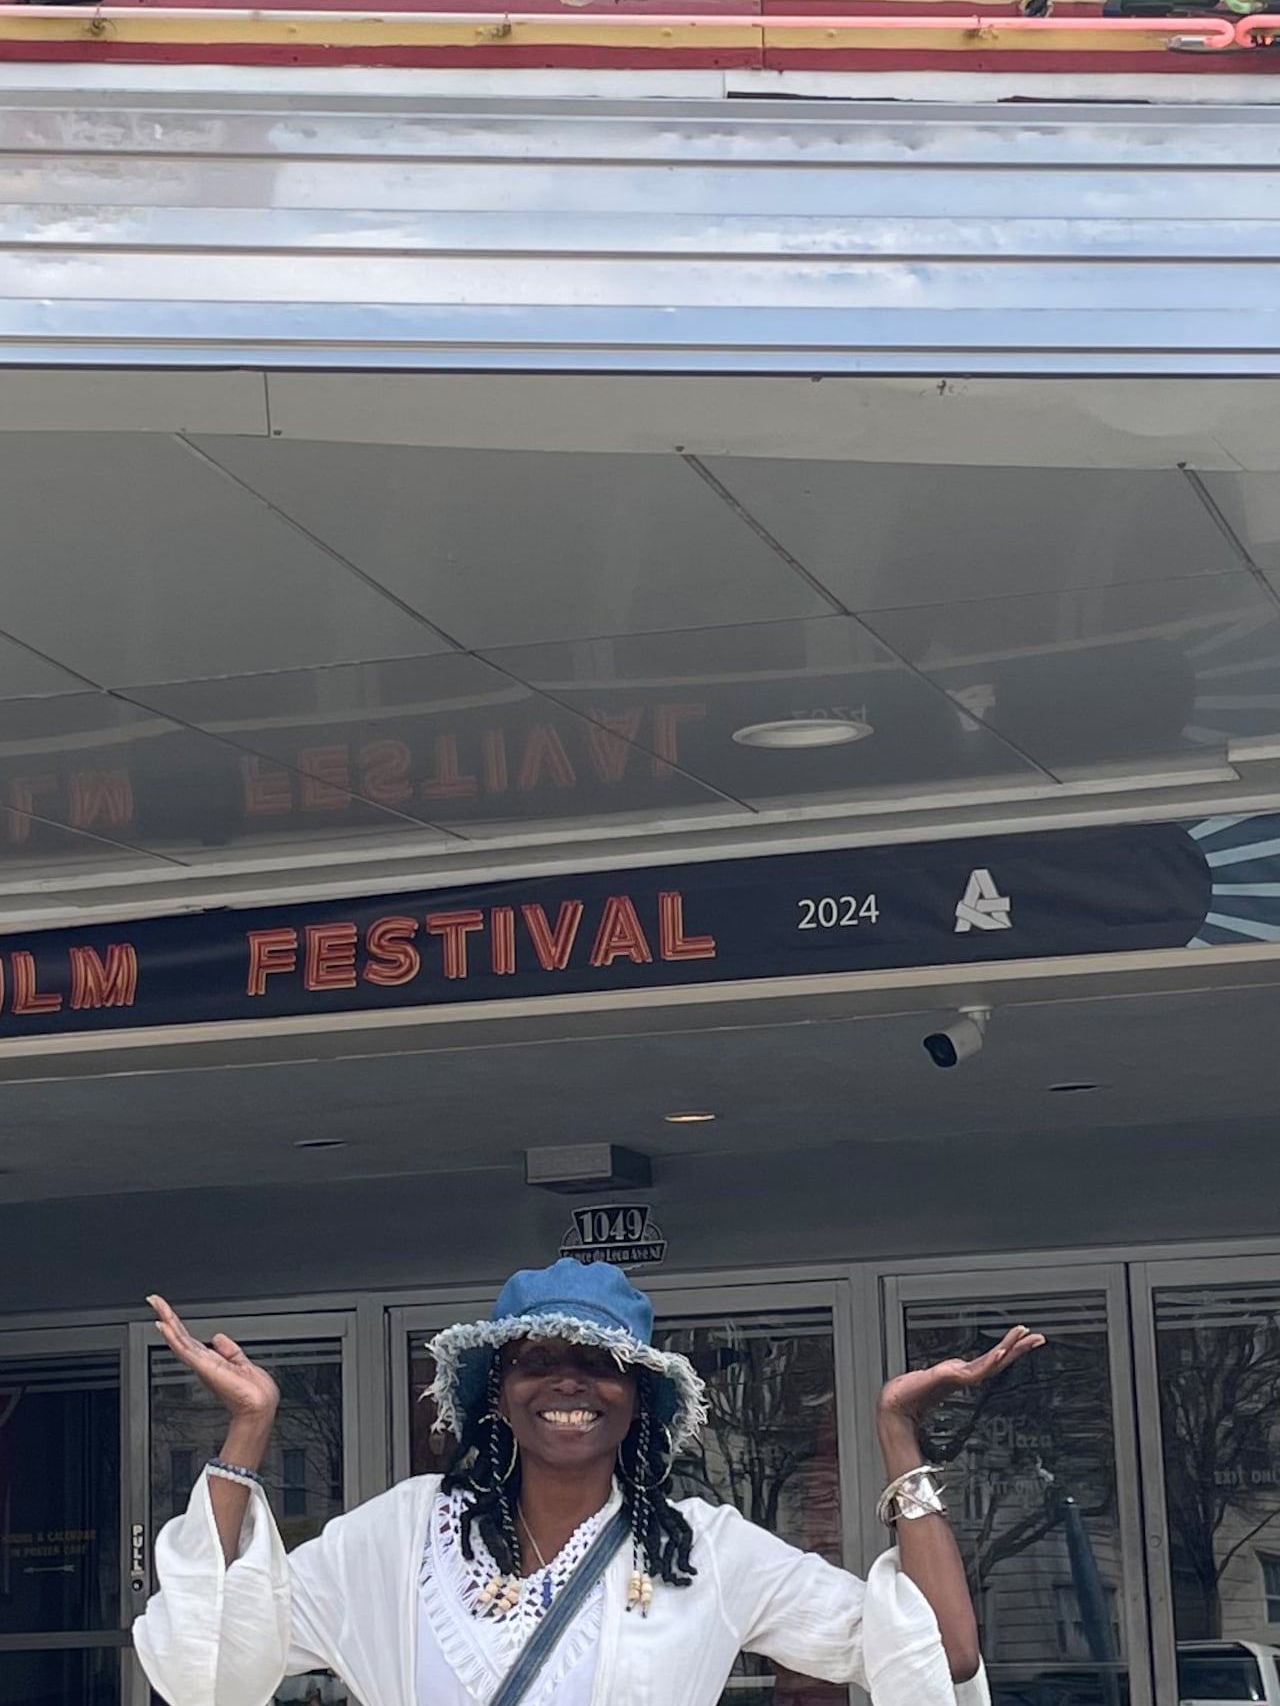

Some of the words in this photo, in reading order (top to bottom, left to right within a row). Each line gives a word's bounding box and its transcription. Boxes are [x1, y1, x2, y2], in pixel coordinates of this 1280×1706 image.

[796, 894, 881, 931] 2024
[245, 890, 716, 997] FESTIVAL
[578, 1208, 643, 1244] 1049
[132, 1524, 144, 1572] PULL
